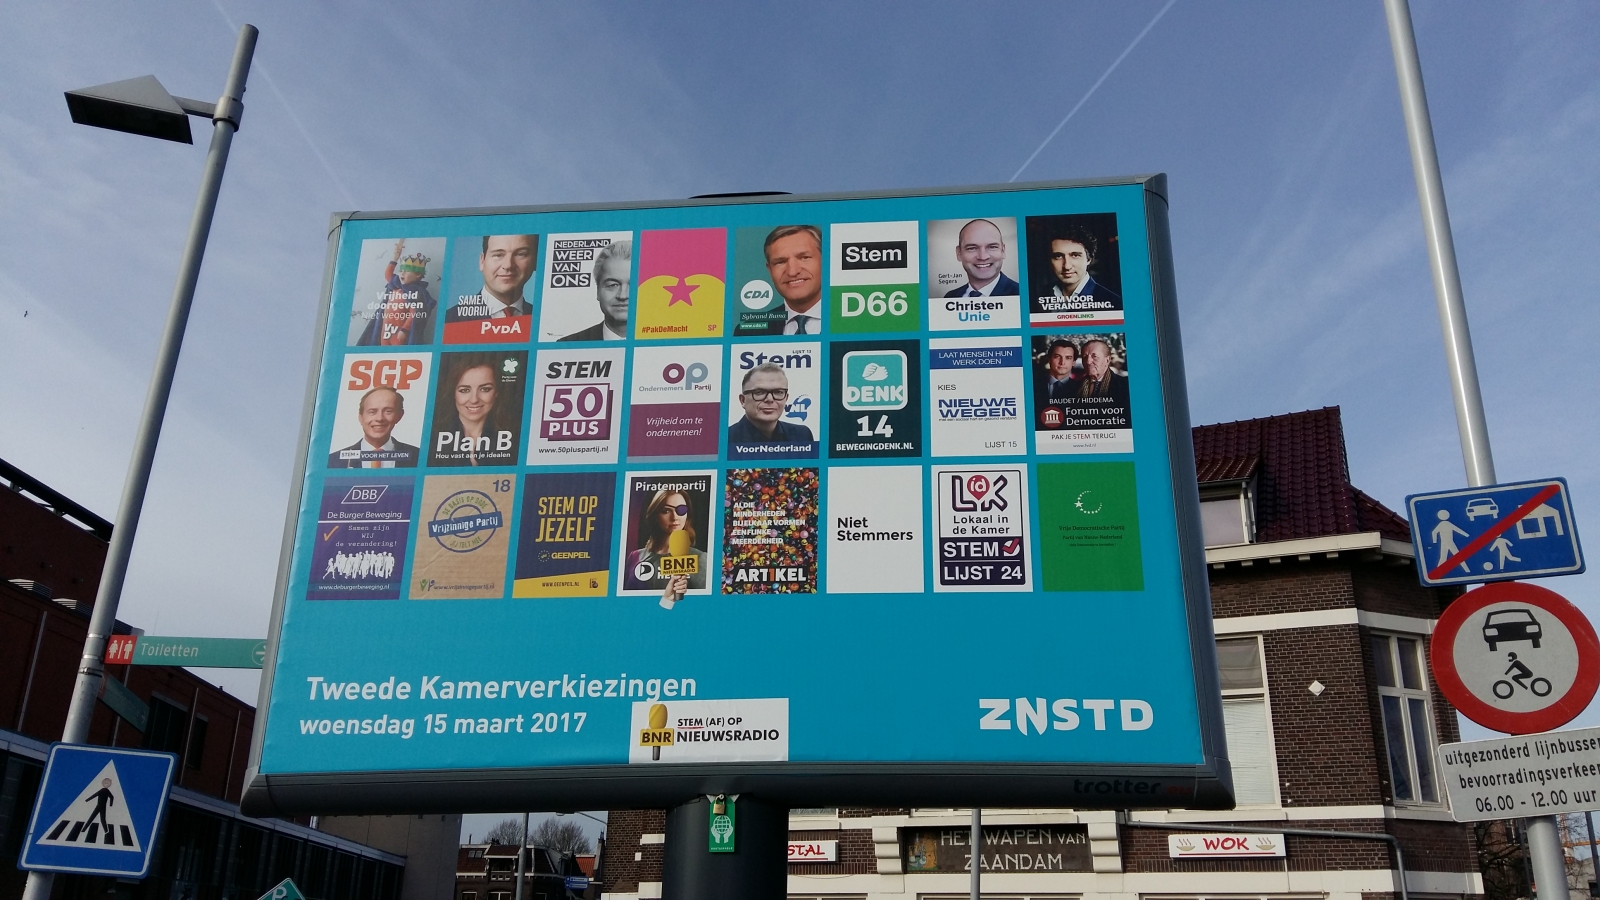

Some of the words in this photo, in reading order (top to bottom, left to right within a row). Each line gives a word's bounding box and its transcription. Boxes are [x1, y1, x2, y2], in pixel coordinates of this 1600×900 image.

[555, 240, 610, 249] NEDERLAND
[555, 250, 591, 260] WEER
[845, 246, 902, 263] Stem
[554, 262, 580, 272] VAN
[552, 274, 590, 288] ONS
[376, 291, 418, 301] Vrijheid
[458, 295, 488, 306] SAMEN
[744, 289, 770, 300] CDA
[367, 300, 424, 310] doorgeven
[842, 291, 908, 317] D66
[946, 301, 1004, 311] Christen
[1042, 302, 1114, 311] VERANDERING.
[361, 311, 379, 320] Niet
[380, 311, 426, 321] weggeven
[458, 306, 494, 317] VOORUIT
[958, 311, 990, 322] Unie
[642, 325, 688, 334] #PakDeMacht
[707, 324, 717, 332] SP
[740, 351, 812, 370] Stem
[348, 360, 423, 390] SGP
[546, 361, 612, 378] STEM
[848, 385, 904, 402] DENK
[549, 386, 604, 419] 50
[938, 398, 1016, 408] NIEUWE
[939, 408, 1016, 418] WEGEN
[1065, 407, 1099, 416] Forum
[646, 416, 678, 427] Vrijheid
[856, 414, 894, 437] 14
[1066, 417, 1126, 426] Democratie
[549, 421, 599, 436] PLUS
[646, 428, 702, 437] ondernemen!
[436, 431, 490, 452] Plan
[496, 430, 513, 450] B
[538, 446, 609, 454] www.50pluspartij.nl
[736, 444, 811, 453] VoorNederland
[479, 452, 485, 460] je
[492, 479, 510, 492] 18
[635, 480, 706, 493] Piratenpartij
[352, 489, 377, 500] DBB
[538, 497, 575, 515] STEM
[578, 496, 598, 514] OP
[340, 512, 364, 520] Burger
[366, 511, 402, 519] Beweging
[953, 515, 993, 524] Lokaal
[997, 514, 1008, 523] in
[432, 521, 474, 533] Vrijzinnige
[476, 516, 498, 527] Partij
[837, 517, 868, 529] Niet
[952, 526, 968, 534] de
[971, 524, 1010, 534] Kamer
[535, 517, 596, 542] JEZELF
[837, 530, 914, 541] Stemmers
[943, 542, 999, 558] STEM
[664, 558, 695, 570] BNR
[944, 566, 994, 581] LIJST
[1001, 565, 1022, 580] 24
[140, 643, 199, 658] Toiletten
[306, 676, 411, 701] Tweede
[419, 672, 697, 702] Kamerverkiezingen
[678, 718, 703, 726] STEM
[706, 717, 724, 727] (AF)
[727, 717, 742, 725] OP
[979, 697, 1154, 736] ZNSTD
[299, 715, 414, 739] woensdag
[424, 714, 447, 734] 15
[454, 714, 524, 734] maart
[530, 712, 587, 733] 2017
[642, 731, 672, 743] BNR
[677, 729, 780, 742] NIEUWSRADIO
[1446, 741, 1530, 767] uitgezonderd
[1074, 779, 1160, 794] trotter
[1476, 792, 1514, 813] 06.00
[1531, 790, 1568, 808] 12.00
[1574, 790, 1596, 803] uur
[941, 830, 971, 846] HET
[983, 829, 1052, 845] WAPEN
[1057, 833, 1086, 844] VAN
[1203, 837, 1249, 851] WOK
[964, 853, 1062, 870] ZAANDAM
